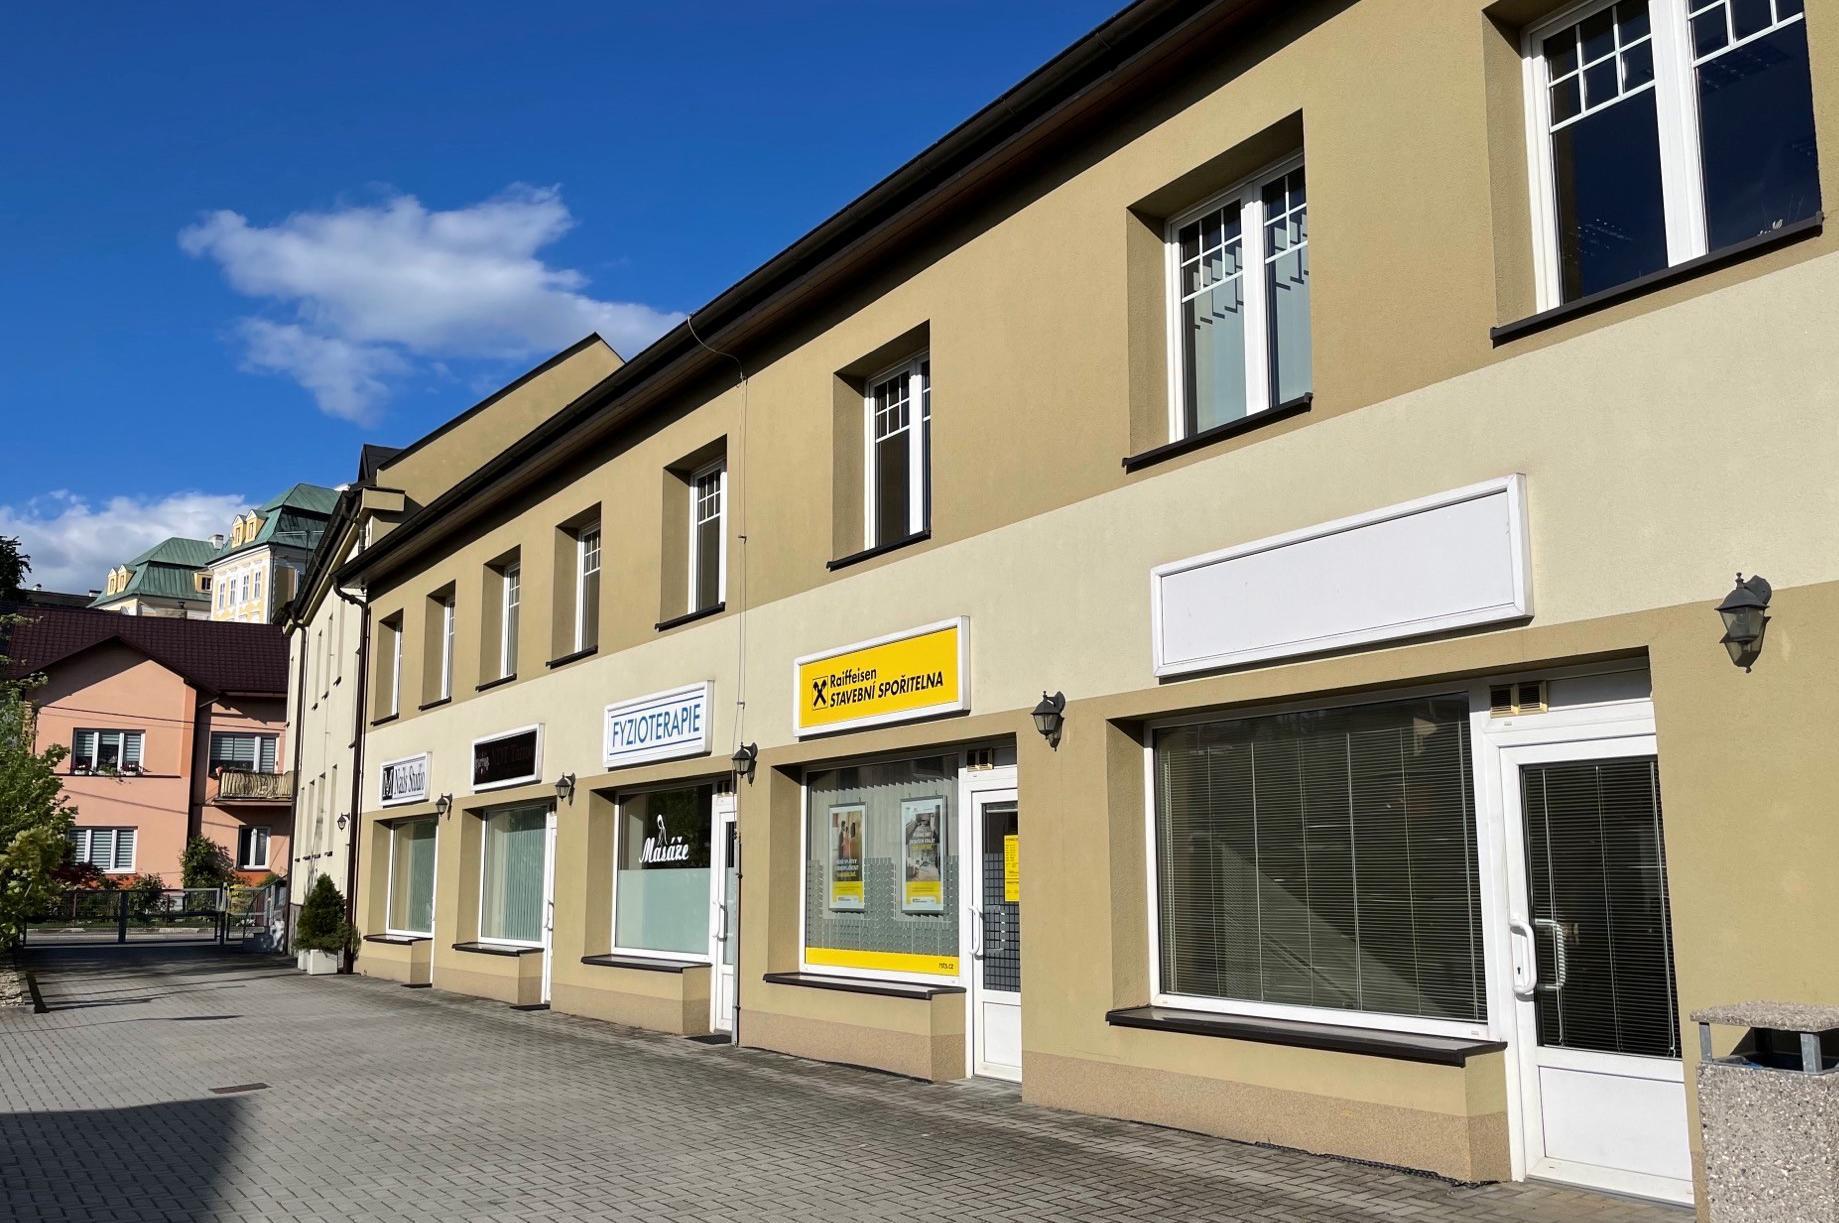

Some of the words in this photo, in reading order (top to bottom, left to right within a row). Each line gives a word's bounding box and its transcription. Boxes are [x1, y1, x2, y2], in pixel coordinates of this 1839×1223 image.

[830, 668, 877, 688] Raiffeisen
[830, 682, 876, 707] STAVEBNÍ
[878, 671, 944, 698] SPOŘITELNA
[612, 703, 701, 747] FYZIOTERAPIE
[639, 836, 689, 863] Masáže
